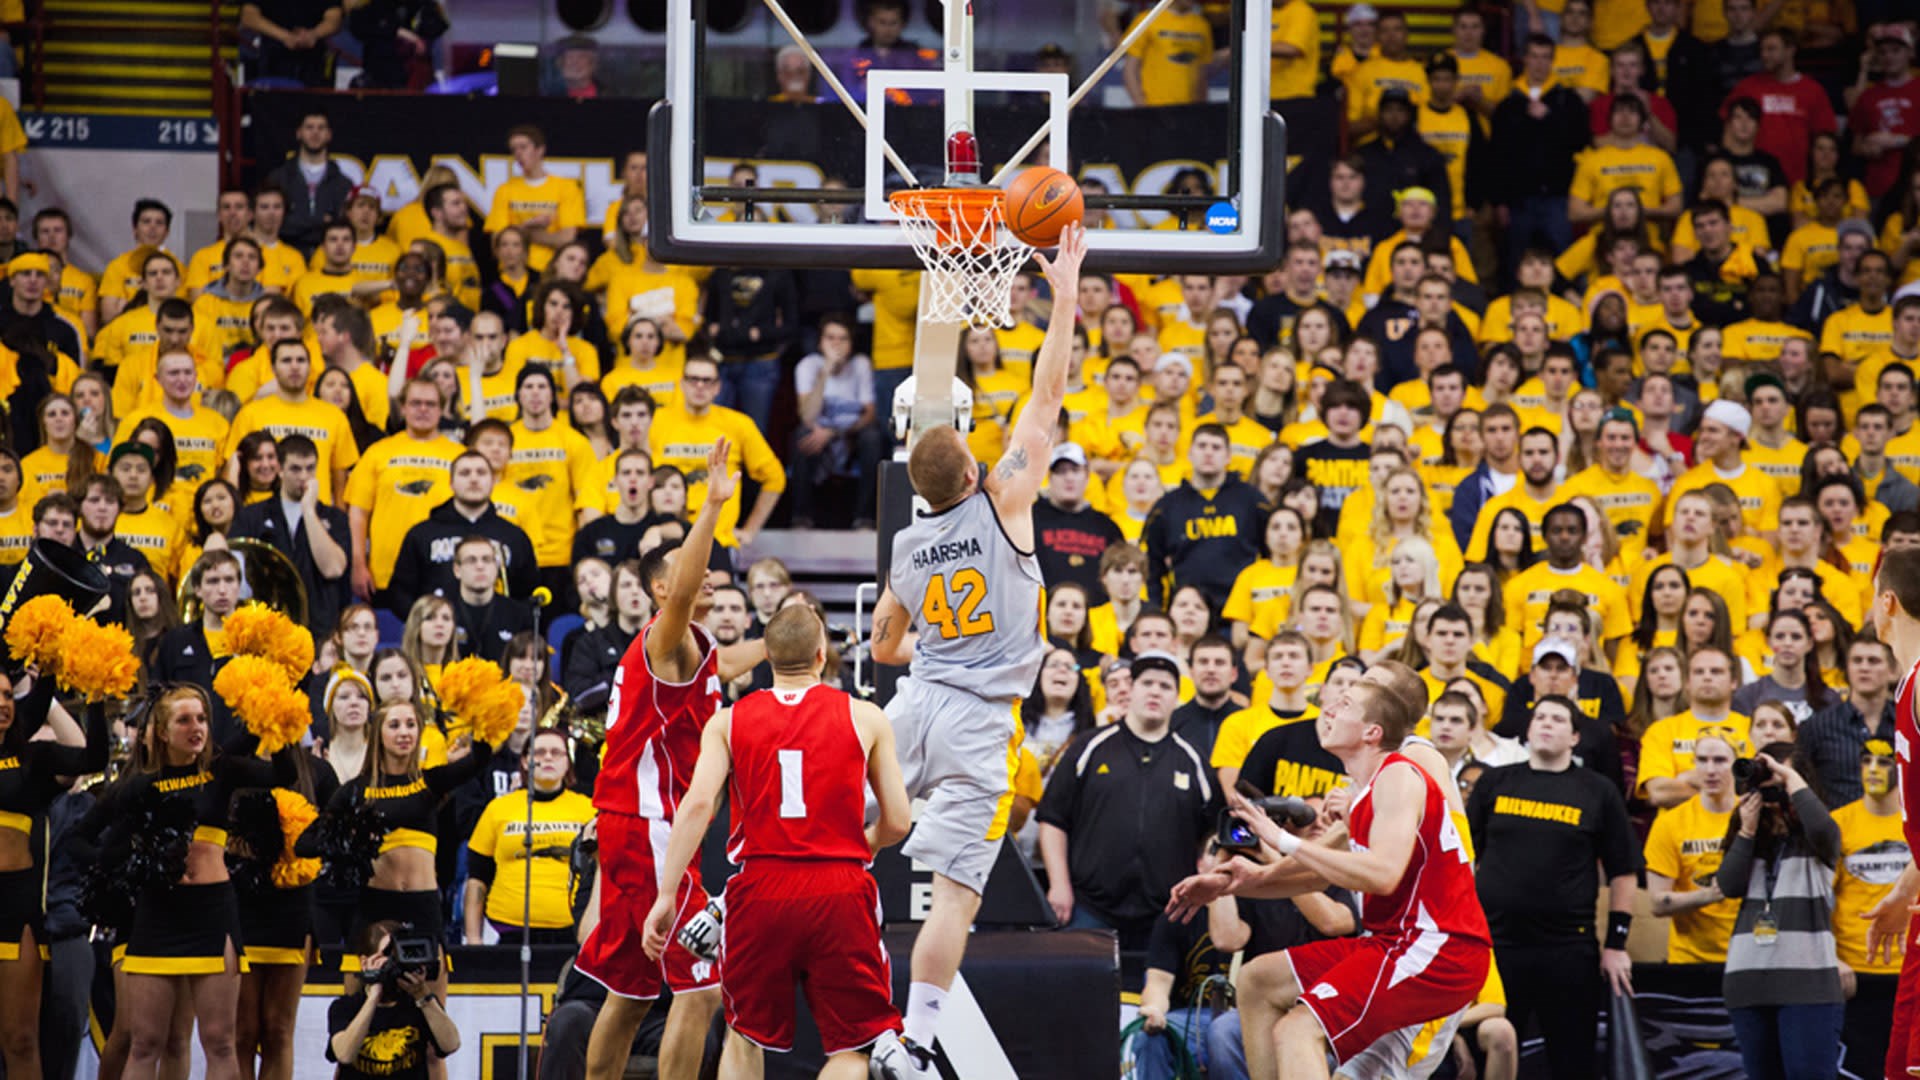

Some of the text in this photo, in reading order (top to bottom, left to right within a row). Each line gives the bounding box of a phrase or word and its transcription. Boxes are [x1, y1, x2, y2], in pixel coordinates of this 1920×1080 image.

[51, 117, 89, 140] 215
[159, 120, 197, 144] 216
[1208, 216, 1237, 227] NCAA
[389, 456, 450, 469] MILWAUKE
[511, 449, 566, 460] ILWAUKEE
[913, 538, 983, 571] HAARSMA
[922, 566, 995, 640] 42
[364, 776, 427, 800] MILWAUKEE
[778, 749, 807, 818] 1
[1274, 758, 1350, 799] PANTH
[1493, 795, 1583, 827] MILWAUKEE
[506, 823, 582, 835] MIWAUKE
